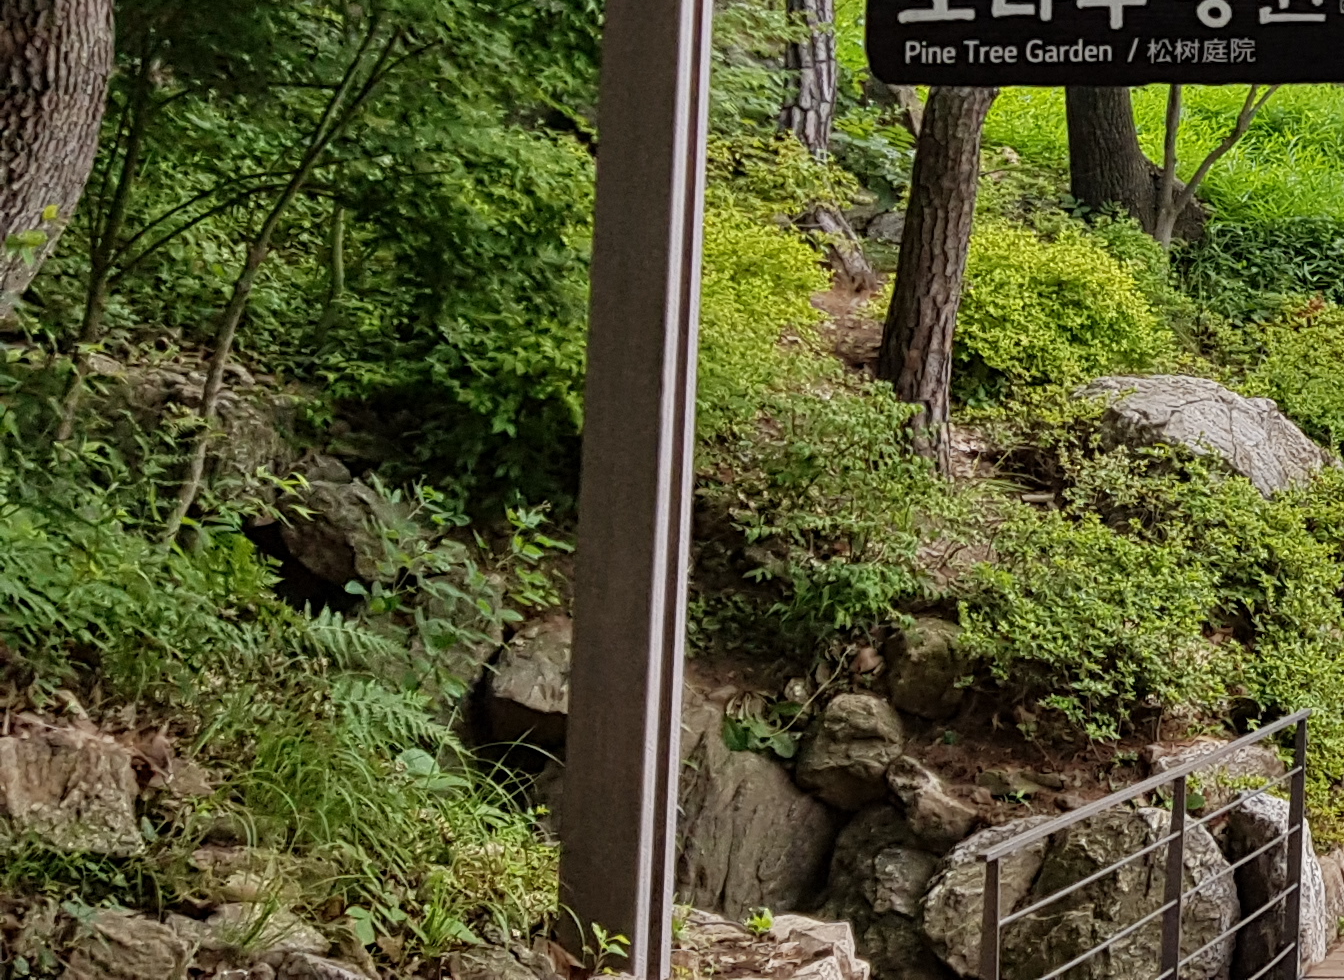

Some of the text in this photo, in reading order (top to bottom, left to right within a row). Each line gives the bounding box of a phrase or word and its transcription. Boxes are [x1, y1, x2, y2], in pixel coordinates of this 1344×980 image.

[905, 37, 1256, 64] Pine Tree Garden / 松树庭院
